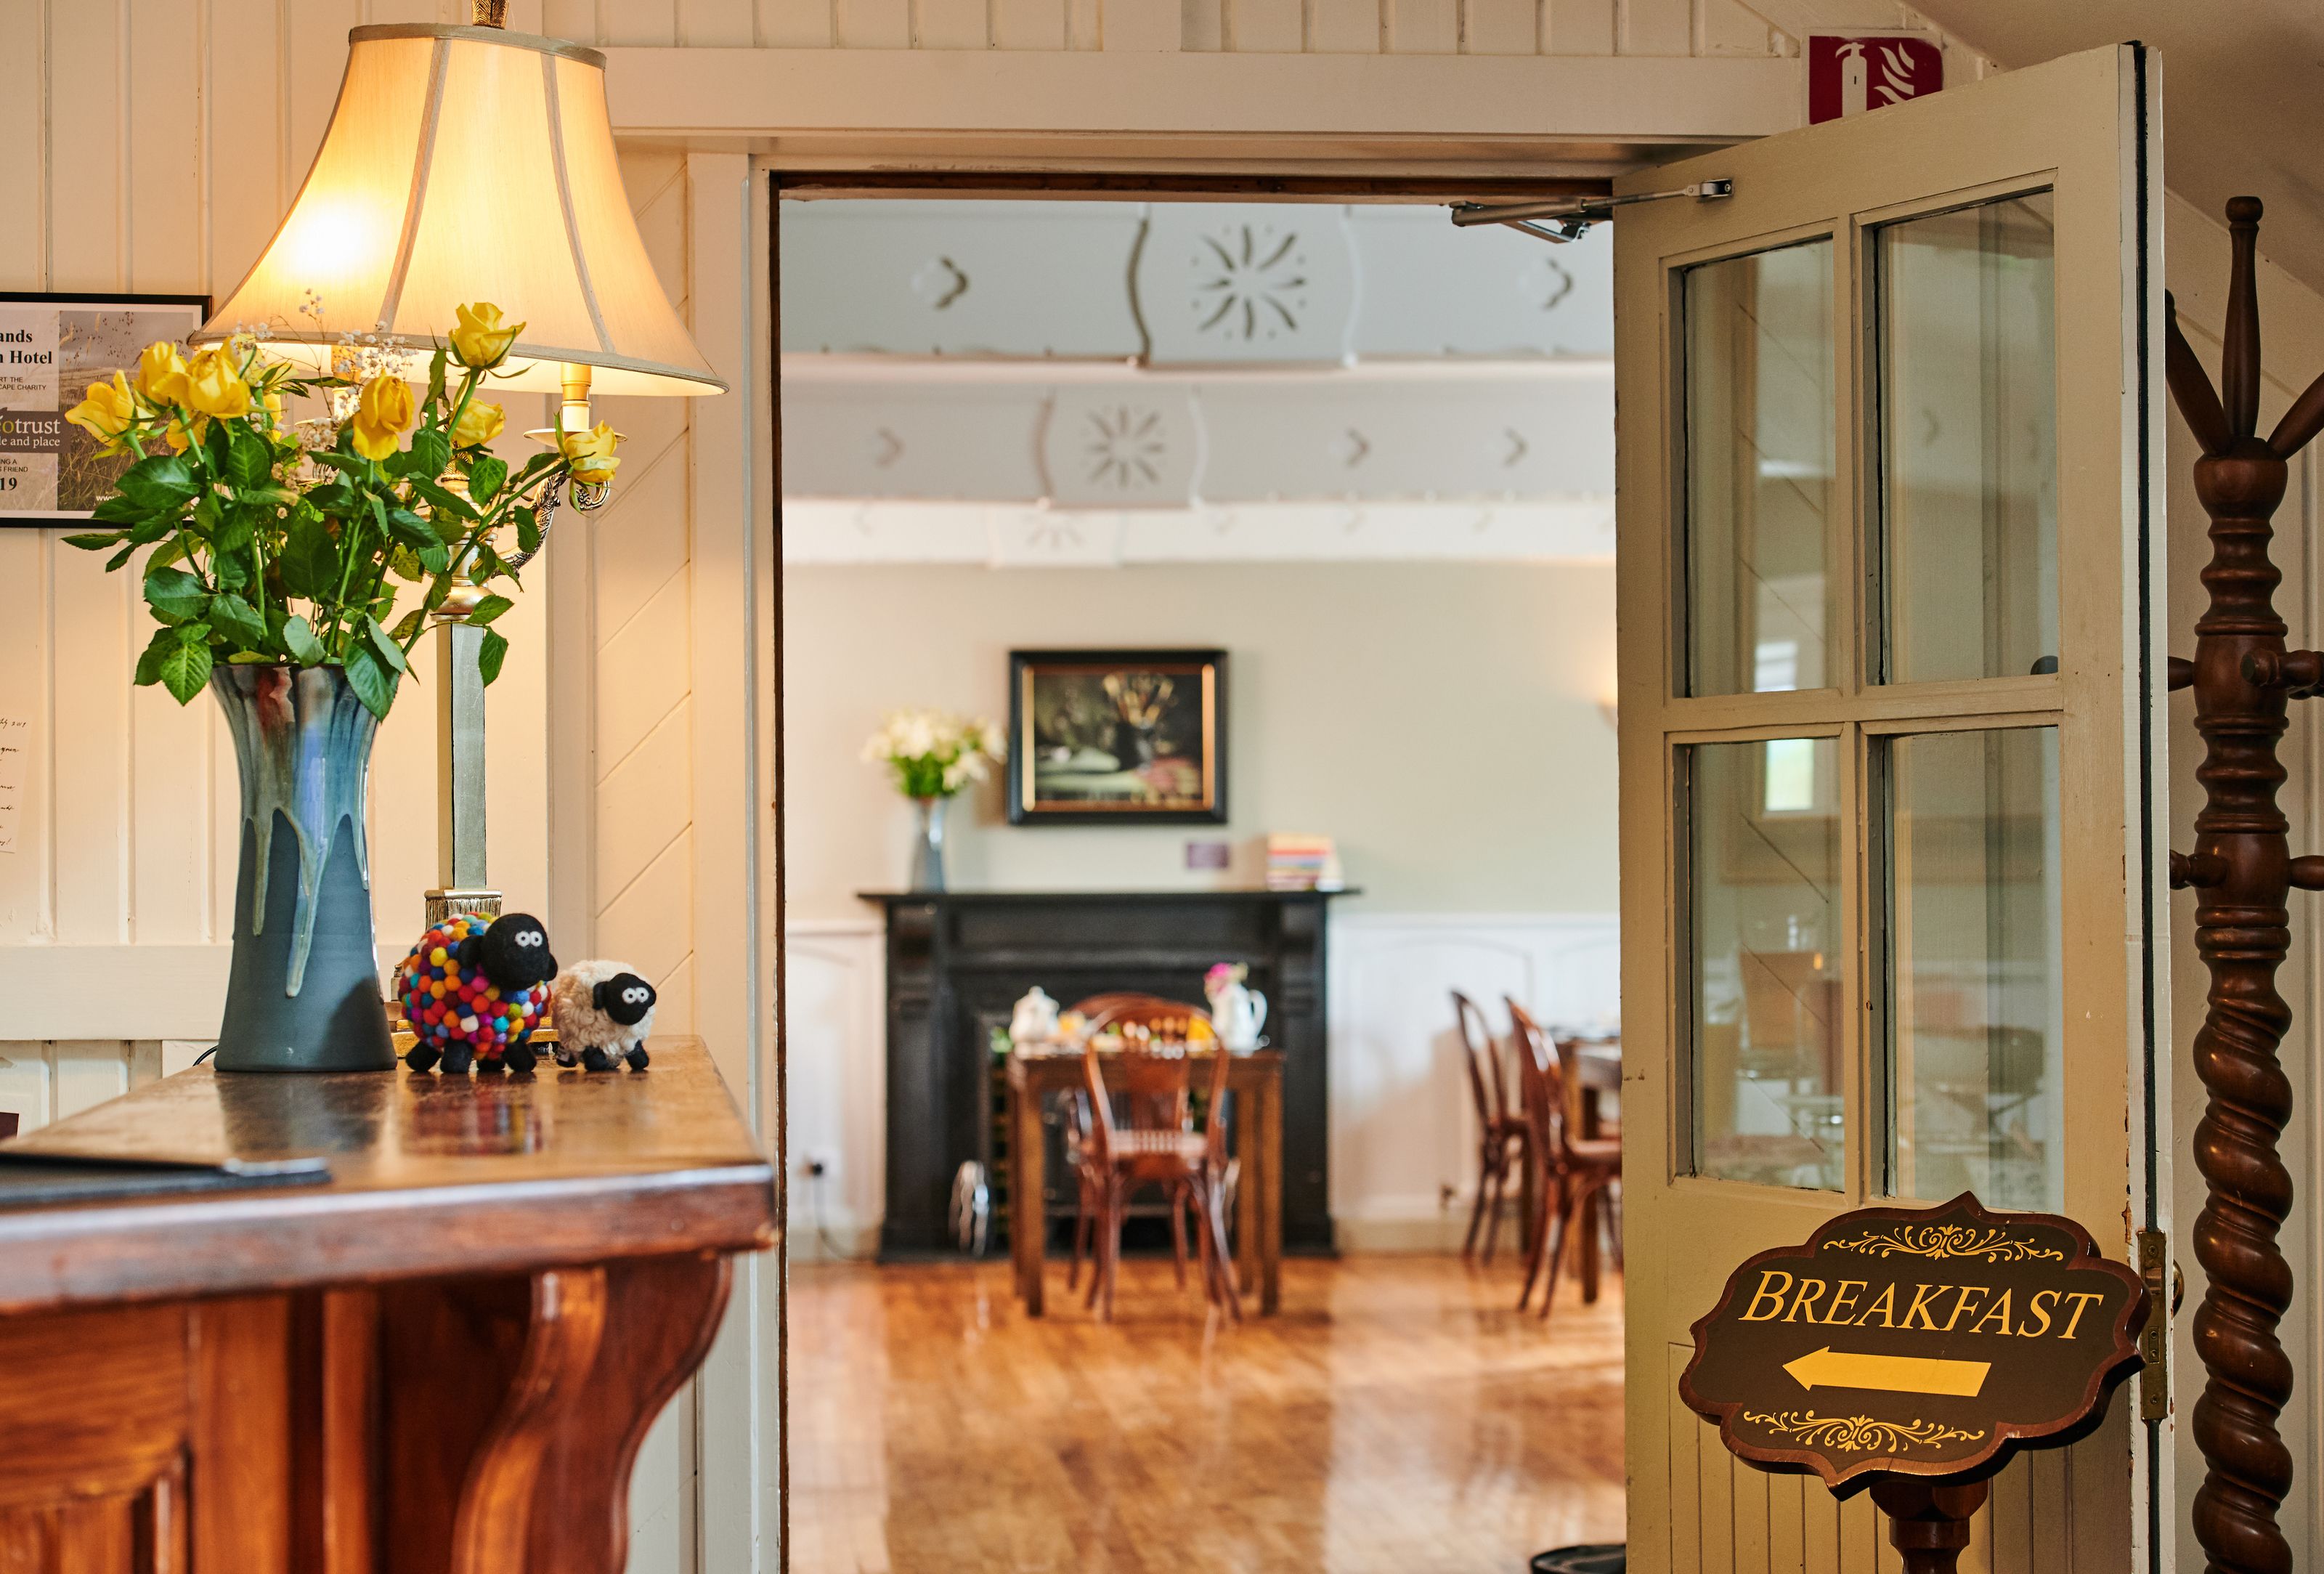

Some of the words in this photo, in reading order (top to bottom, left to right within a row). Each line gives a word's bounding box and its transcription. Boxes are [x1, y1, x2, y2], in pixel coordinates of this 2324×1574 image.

[10, 350, 52, 364] Hotel
[0, 418, 61, 434] otrust
[10, 437, 30, 446] and
[33, 437, 60, 449] place
[1738, 1270, 2105, 1340] BREAKFAST
